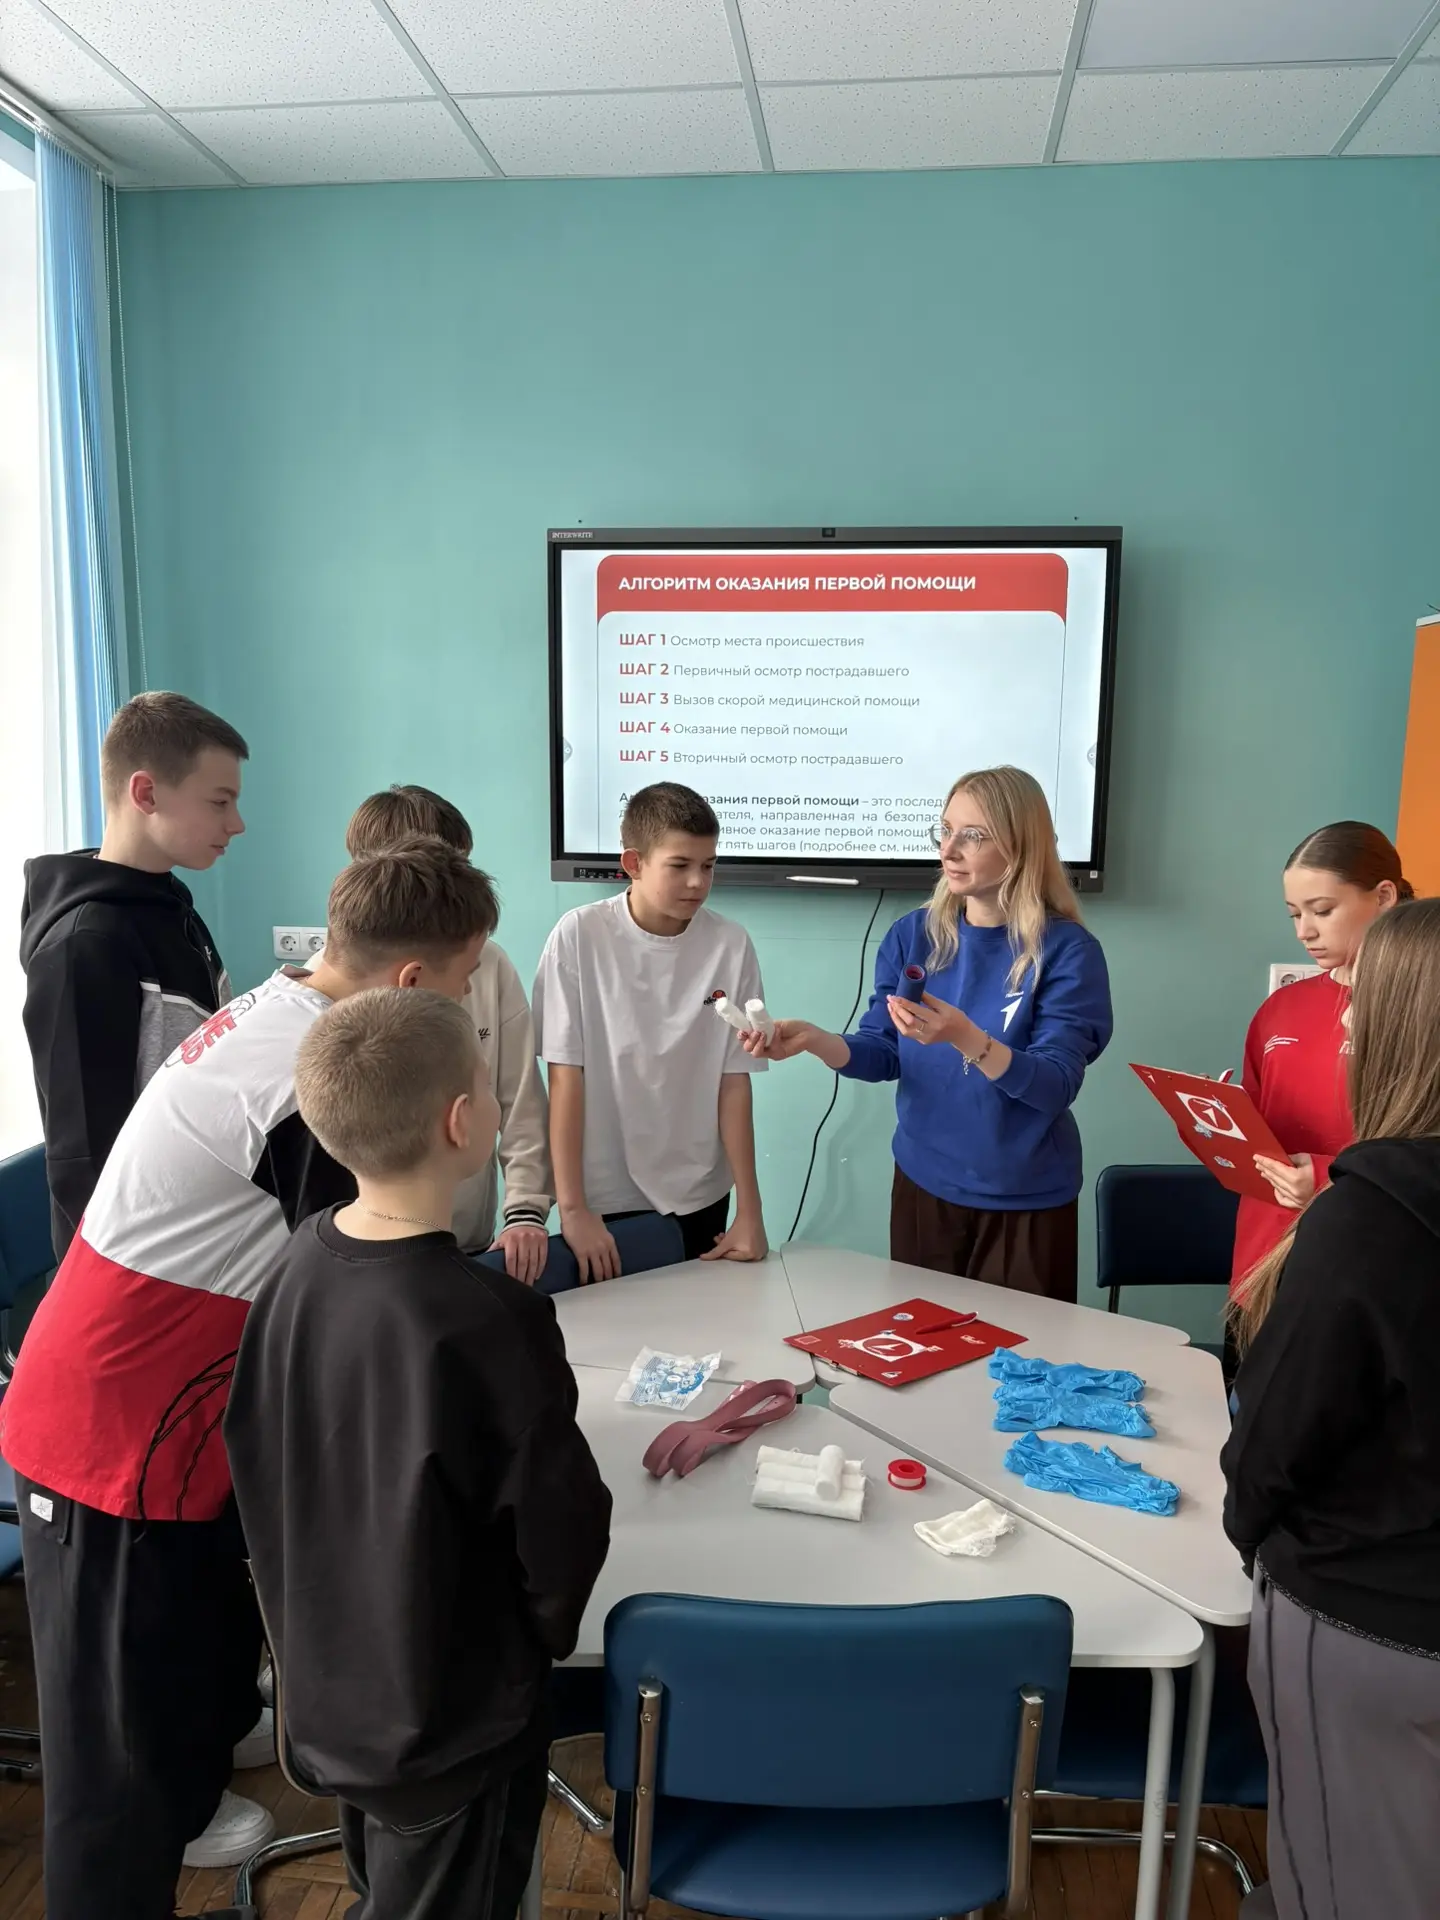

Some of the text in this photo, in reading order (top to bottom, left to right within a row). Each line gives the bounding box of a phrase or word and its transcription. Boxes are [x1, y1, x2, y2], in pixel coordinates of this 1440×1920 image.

[618, 573, 977, 592] АЛГОРИТМ ОКАЗАНИЯ ПЕРВОЙ ПОМОЩИ
[619, 633, 865, 650] ШАГ 1 Осмотр места происшествия
[619, 662, 910, 679] ШАГ 2 Первичный осмотр пострадавшего
[619, 692, 921, 708] ШАГ 3 Вызов скорой медицинской помощи
[619, 721, 848, 737] ШАГ 4 Оказание первой помощи
[619, 750, 904, 767] ШАГ 5 Вторичный осмотр пострадавшего
[703, 796, 748, 806] зания
[751, 794, 800, 808] первой
[803, 796, 859, 808] помощи
[871, 797, 892, 807] это
[716, 810, 940, 824] ателя, направленная на безопас
[720, 826, 756, 836] ивное
[760, 826, 821, 837] оказание
[824, 826, 874, 839] первой
[725, 841, 754, 850] пять
[757, 841, 796, 851] шагов
[800, 840, 877, 853] (подробнее
[879, 844, 899, 852] см.
